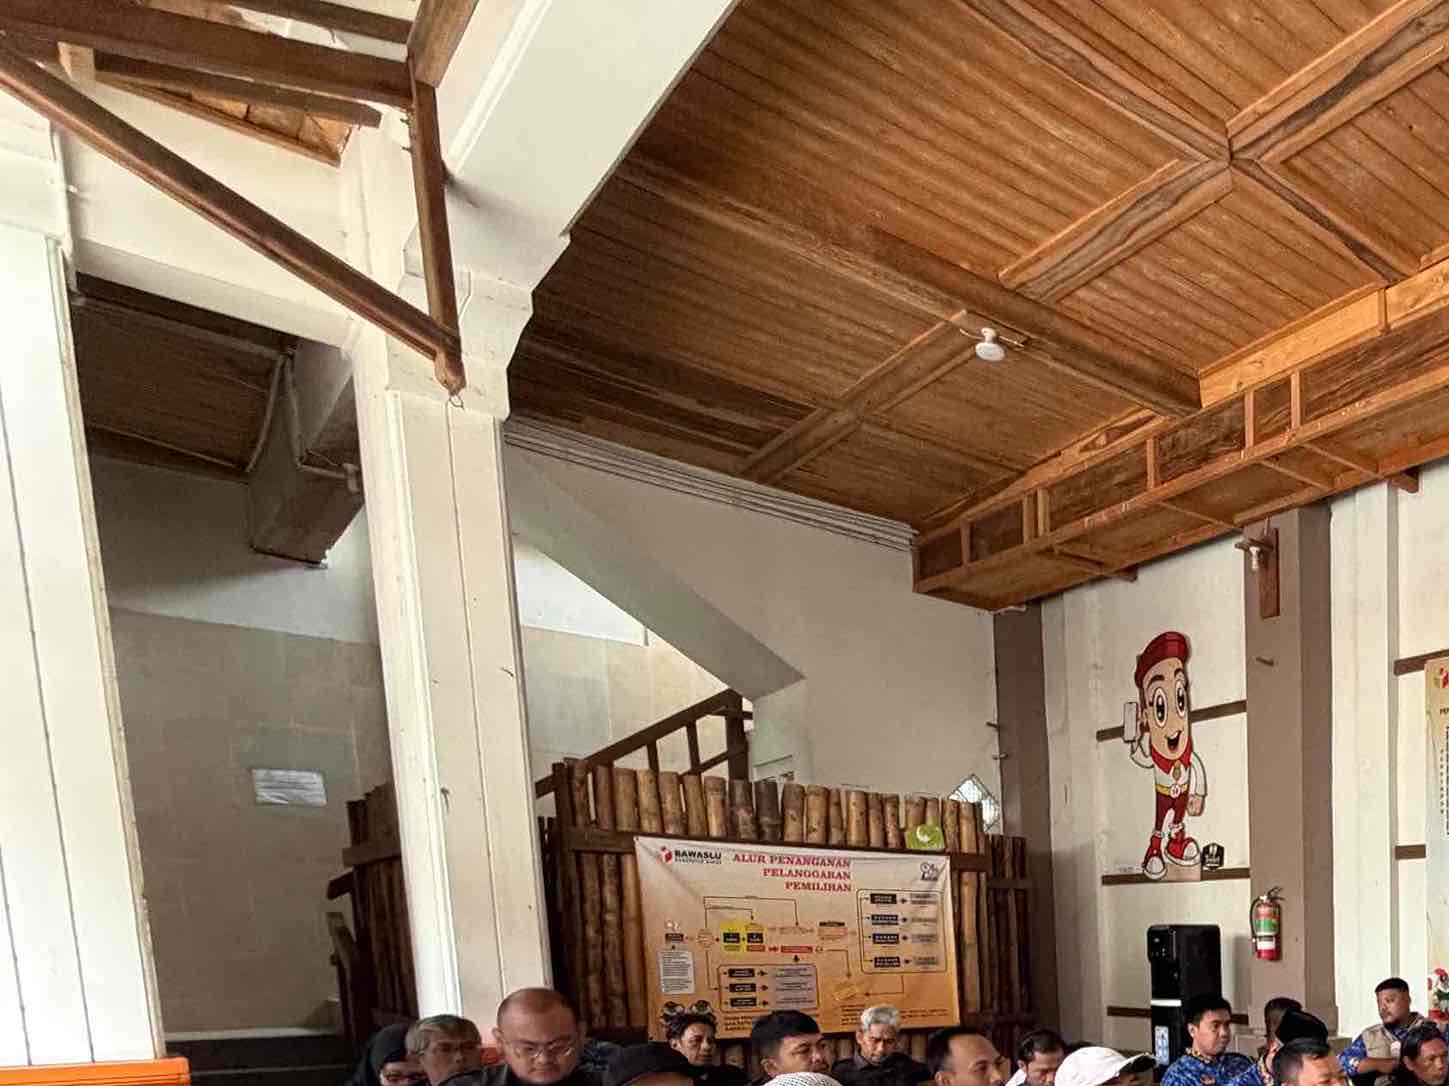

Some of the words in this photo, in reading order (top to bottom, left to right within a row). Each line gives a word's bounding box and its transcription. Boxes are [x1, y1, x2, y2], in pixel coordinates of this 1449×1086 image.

[732, 853, 767, 864] ALUR
[769, 854, 851, 868] PENANGANAN
[762, 868, 851, 880] PELANGGARAN
[784, 881, 852, 892] PEMILIHAN
